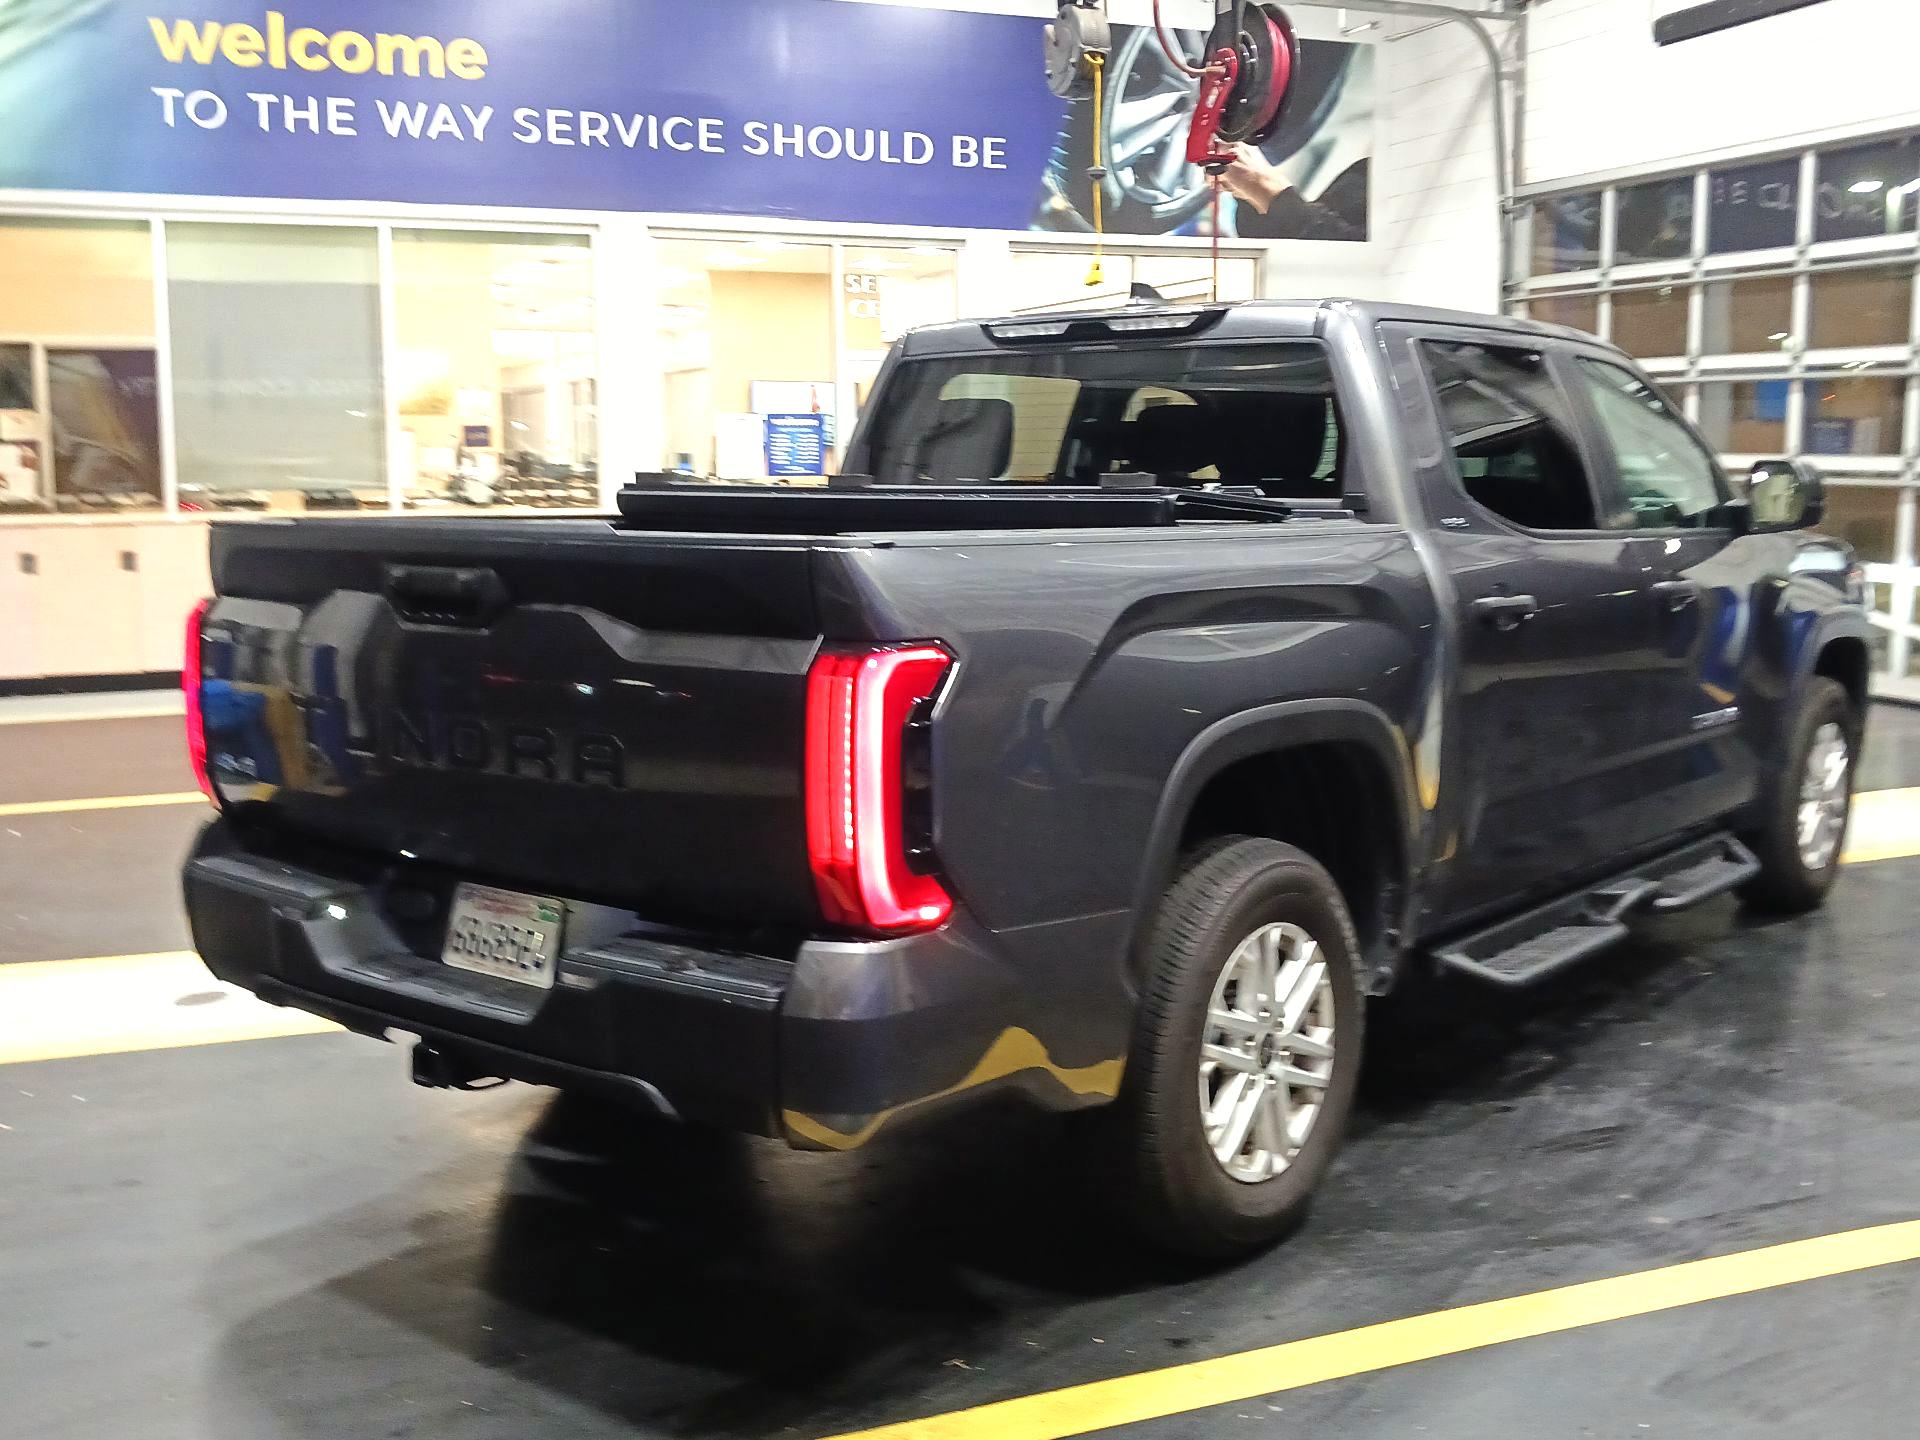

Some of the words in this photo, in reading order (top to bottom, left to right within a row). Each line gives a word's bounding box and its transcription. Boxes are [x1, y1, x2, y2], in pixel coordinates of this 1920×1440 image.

[147, 10, 488, 80] welcome
[151, 87, 228, 129] TO
[247, 92, 357, 136] THE
[375, 99, 494, 142] WAY
[512, 107, 725, 154] SERVICE
[742, 121, 934, 165] SHOULD
[952, 135, 1008, 170] BE
[340, 705, 626, 790] NDRA
